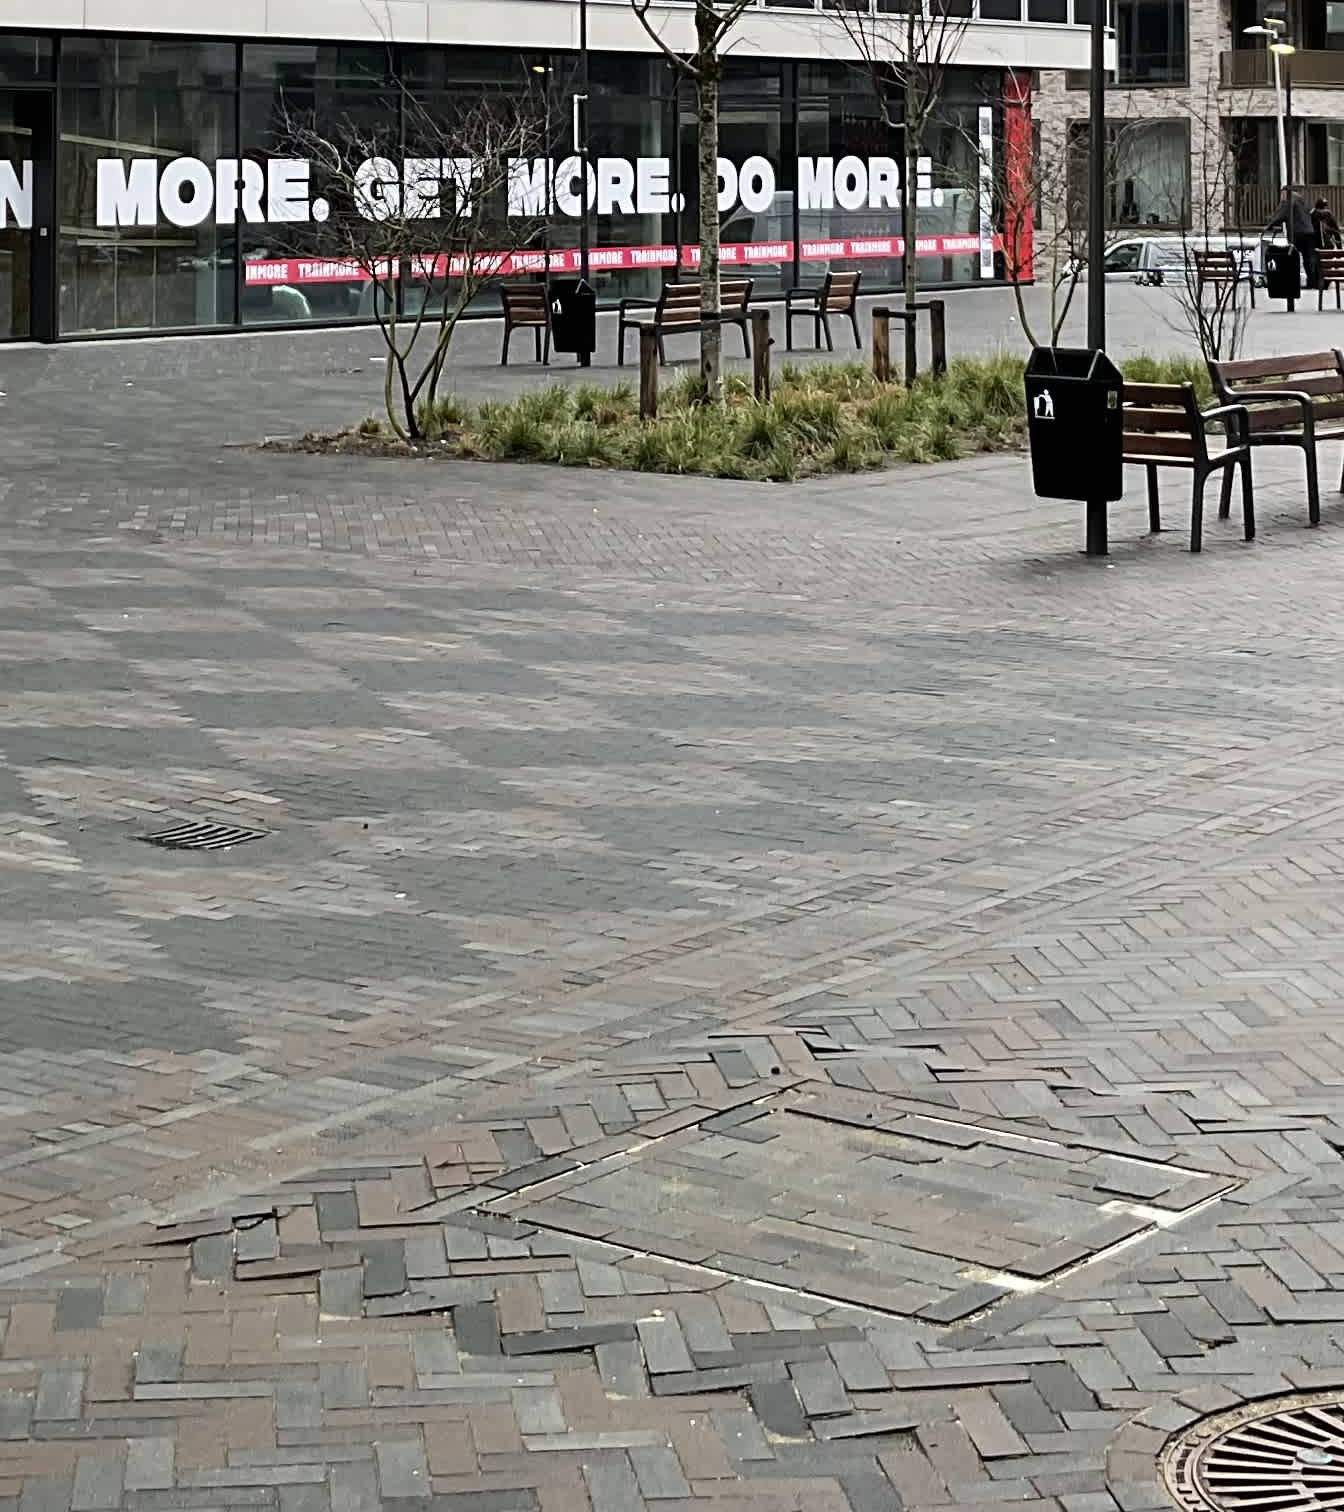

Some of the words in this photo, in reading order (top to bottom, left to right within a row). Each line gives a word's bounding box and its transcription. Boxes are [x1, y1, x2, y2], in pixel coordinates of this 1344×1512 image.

[96, 156, 330, 227] MORE.
[354, 156, 483, 222] GET
[507, 155, 686, 217] MORE.
[797, 155, 945, 210] MORE.
[297, 261, 359, 278] TRAINMORE
[572, 250, 623, 267] TRINMORE
[743, 245, 788, 259] TRAINMORE
[801, 242, 845, 257] TRAINMORE
